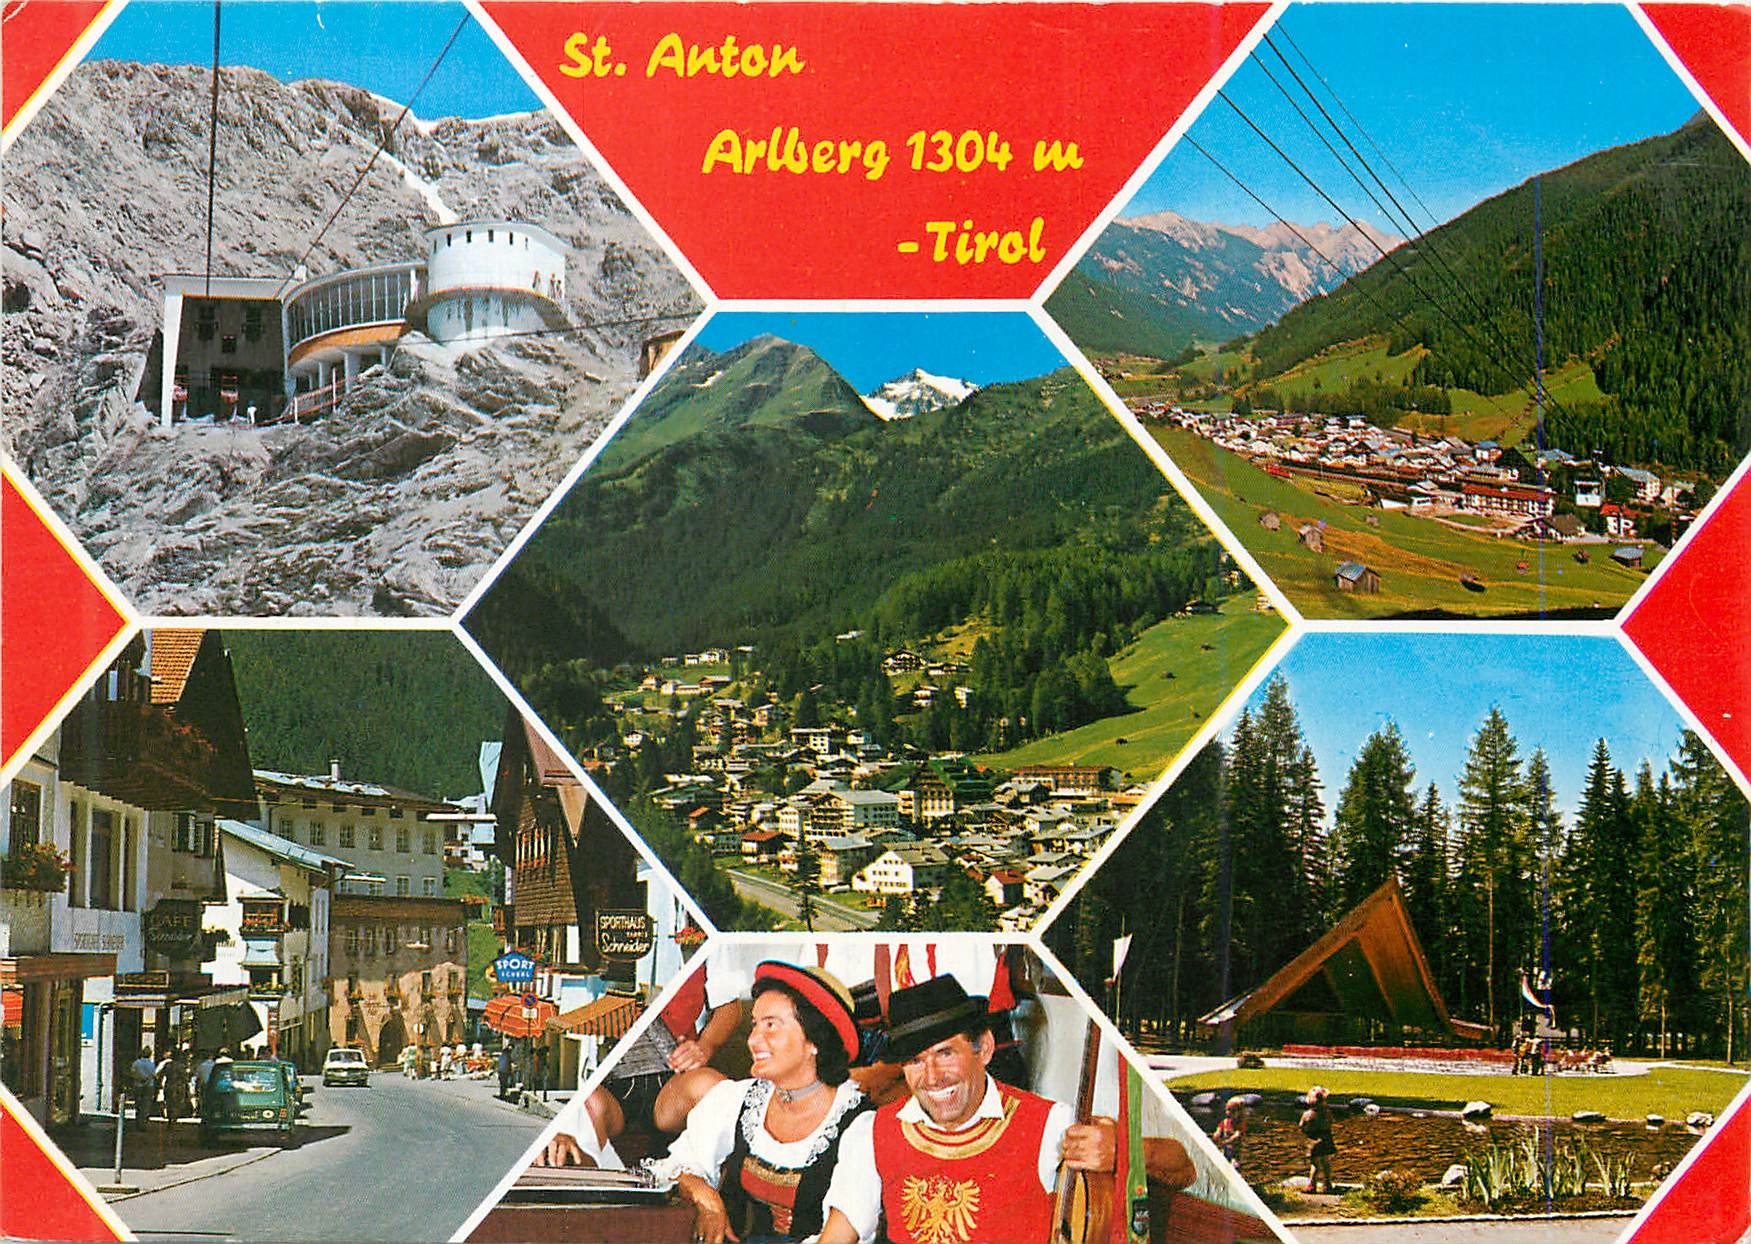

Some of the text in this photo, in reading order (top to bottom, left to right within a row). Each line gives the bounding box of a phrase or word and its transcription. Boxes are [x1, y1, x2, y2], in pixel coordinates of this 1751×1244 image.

[600, 916, 645, 929] SPORTHAUS
[602, 932, 650, 953] Schneider
[496, 958, 535, 970] SPORT
